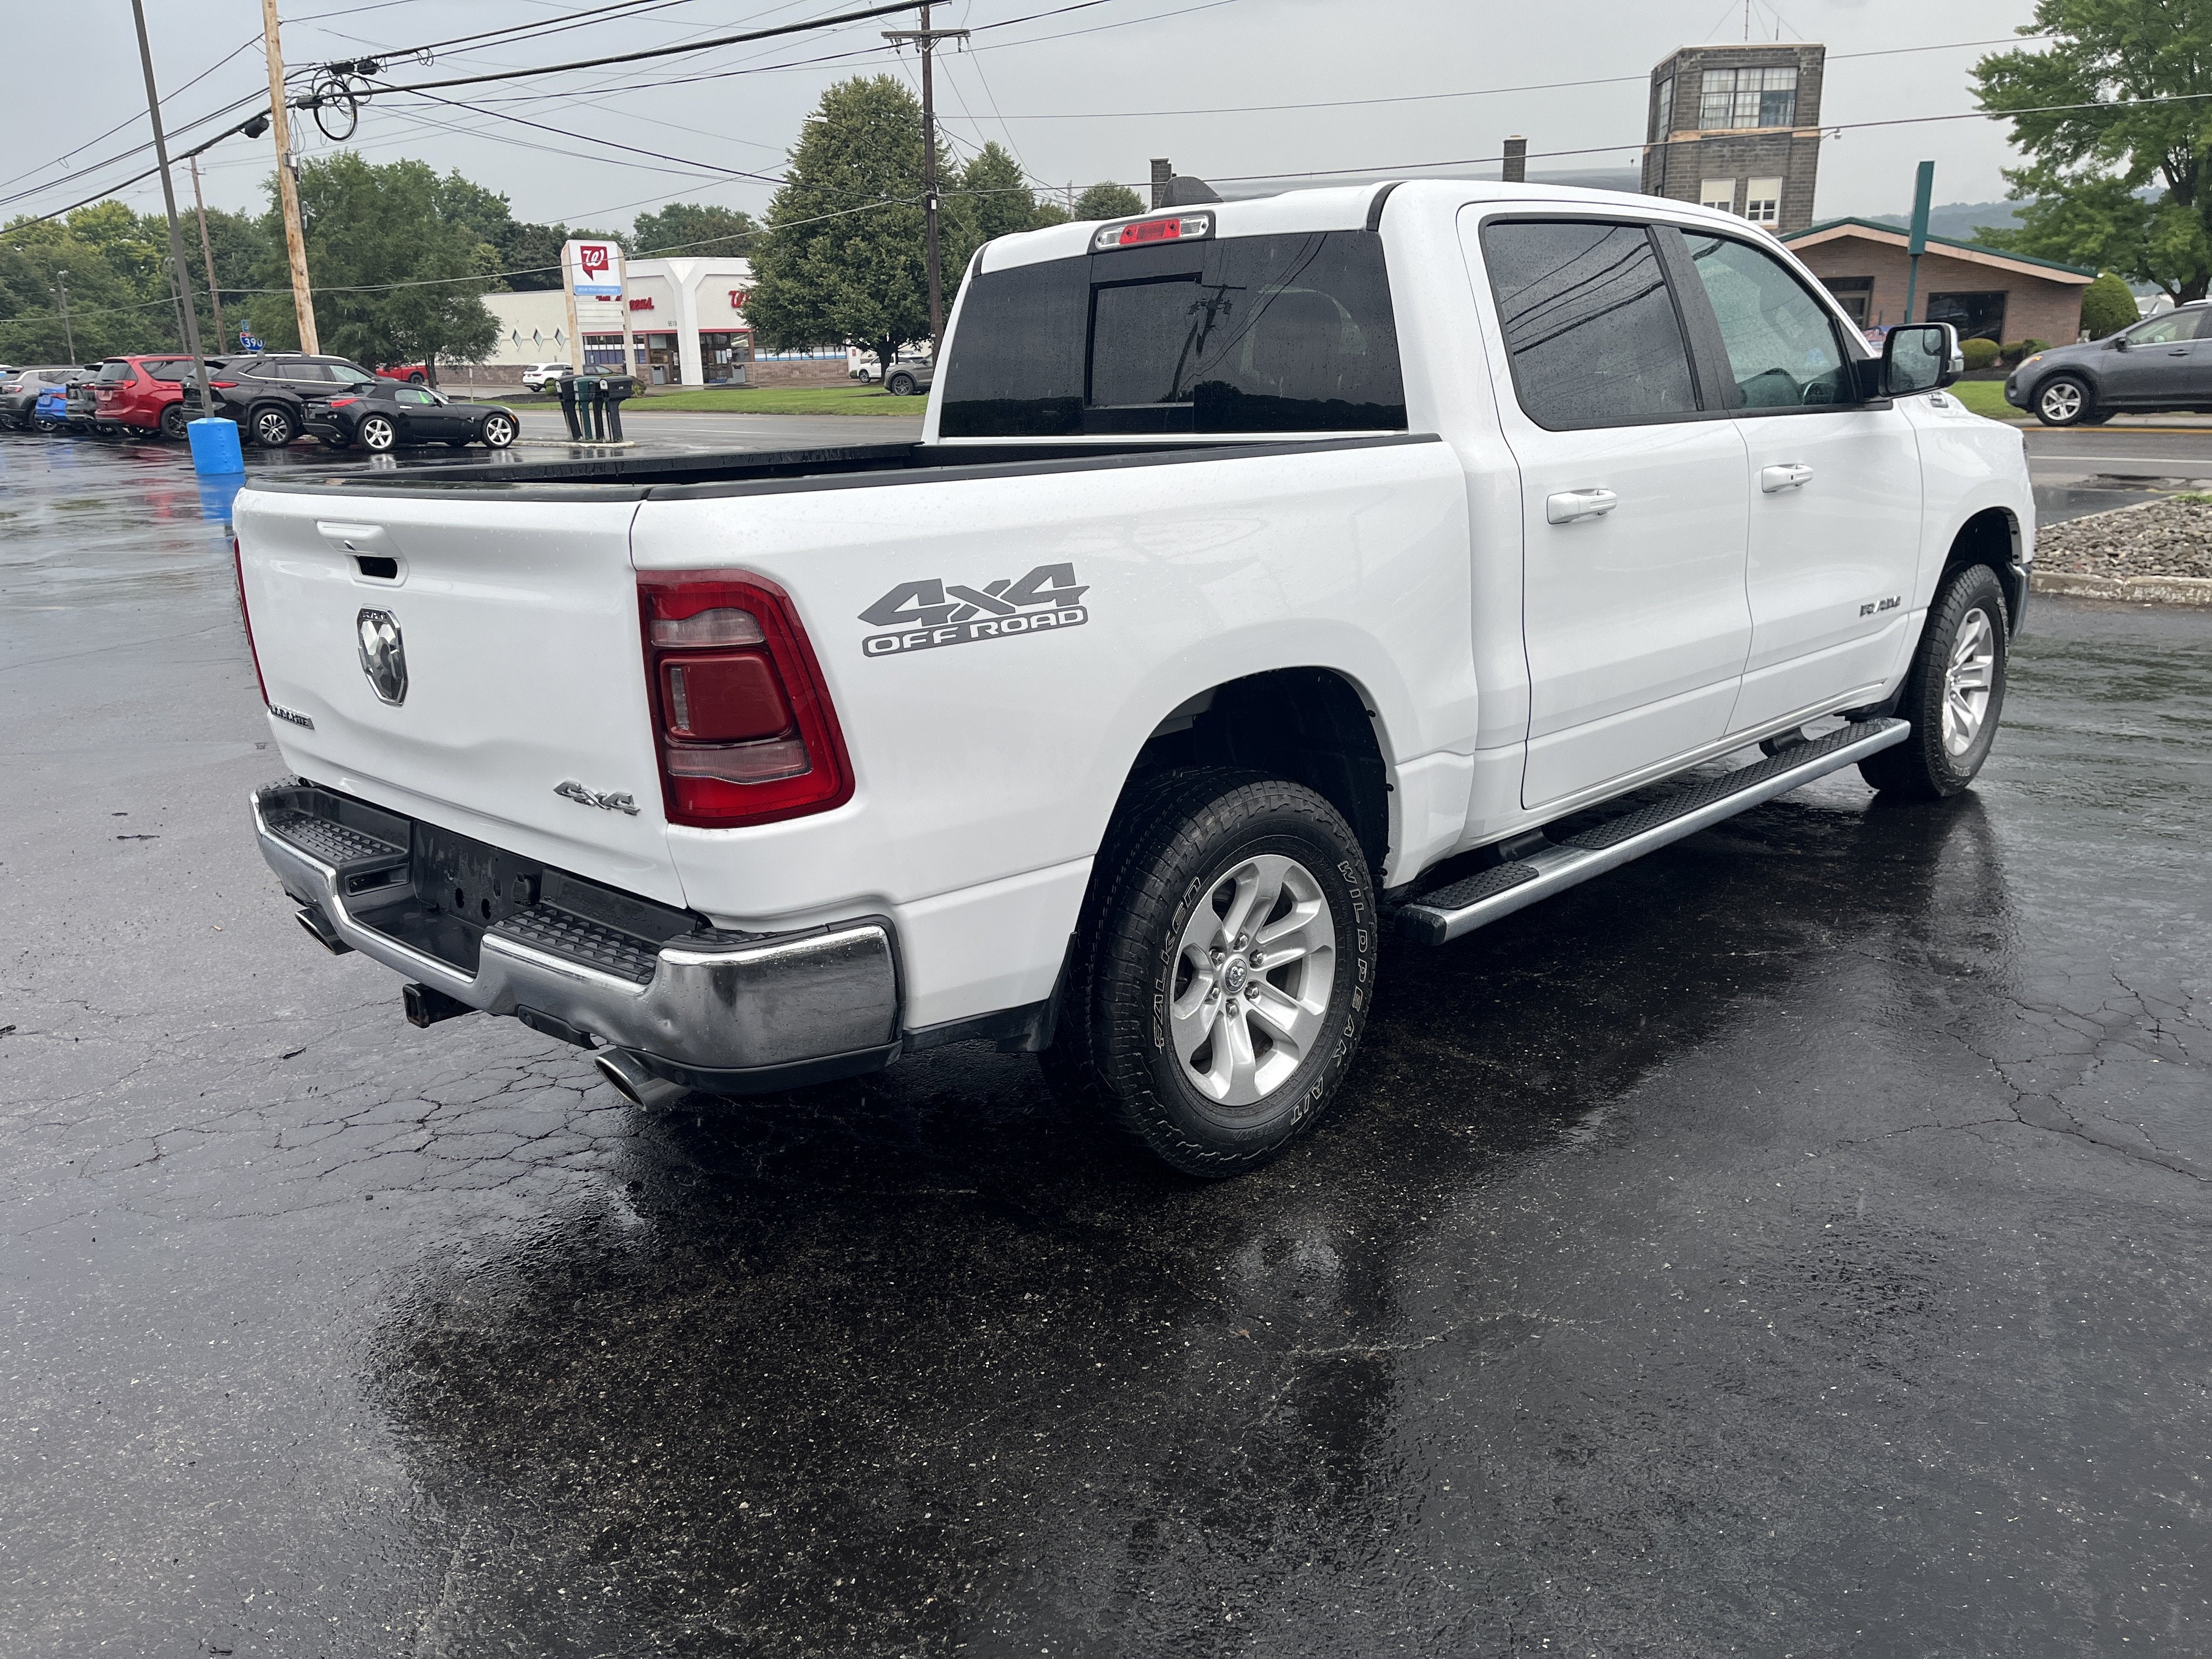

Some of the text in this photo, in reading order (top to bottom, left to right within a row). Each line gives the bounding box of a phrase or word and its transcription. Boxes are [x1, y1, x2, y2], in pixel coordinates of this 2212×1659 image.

[244, 337, 263, 347] 390
[1859, 596, 1901, 617] RAM
[867, 608, 1084, 654] OFF ROAD
[1333, 860, 1368, 1068] WILDPEAK
